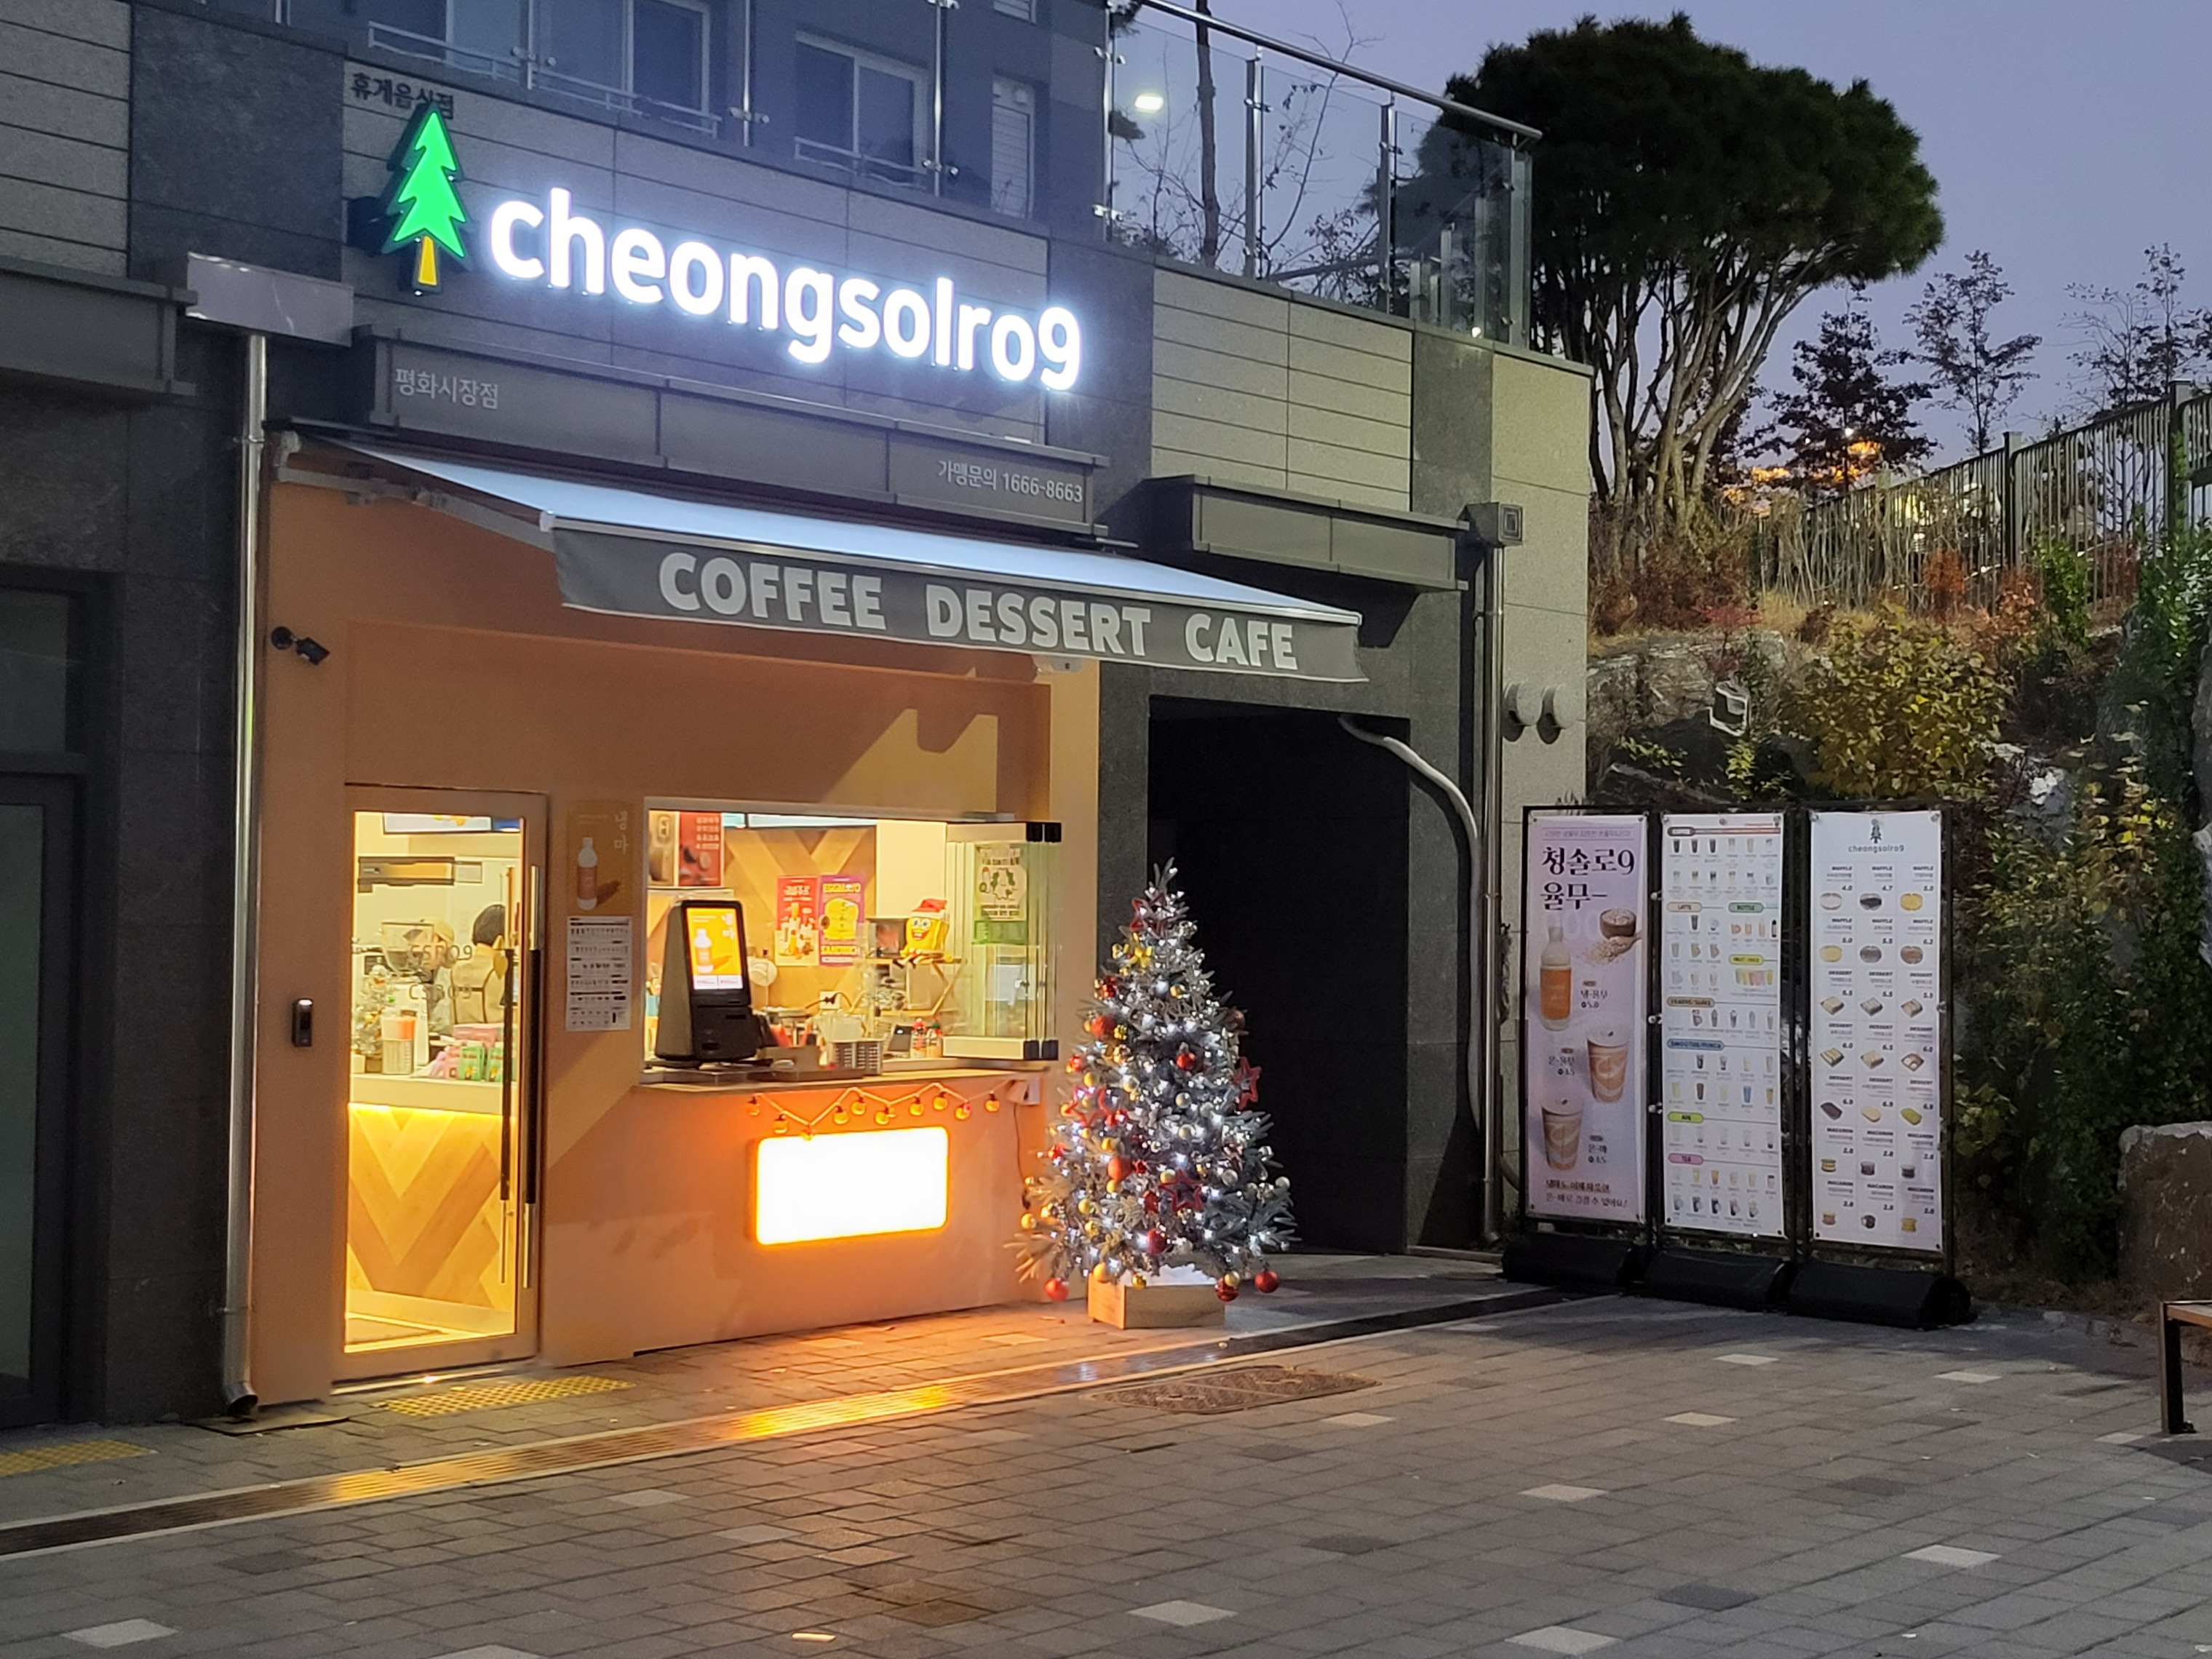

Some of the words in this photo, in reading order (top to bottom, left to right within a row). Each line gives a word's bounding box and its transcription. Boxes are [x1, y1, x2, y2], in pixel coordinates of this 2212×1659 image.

[490, 187, 1081, 391] cheongsolro9
[395, 368, 498, 410] 평화시장점
[938, 460, 997, 491] 가맹문의
[1002, 472, 1083, 503] 1666-8663
[659, 552, 887, 631] COFFEE
[925, 583, 1152, 656] DESSERT
[1184, 613, 1299, 670] CAFE
[1542, 846, 1635, 876] 청솔로9
[1848, 845, 1905, 854] cheongsolro9
